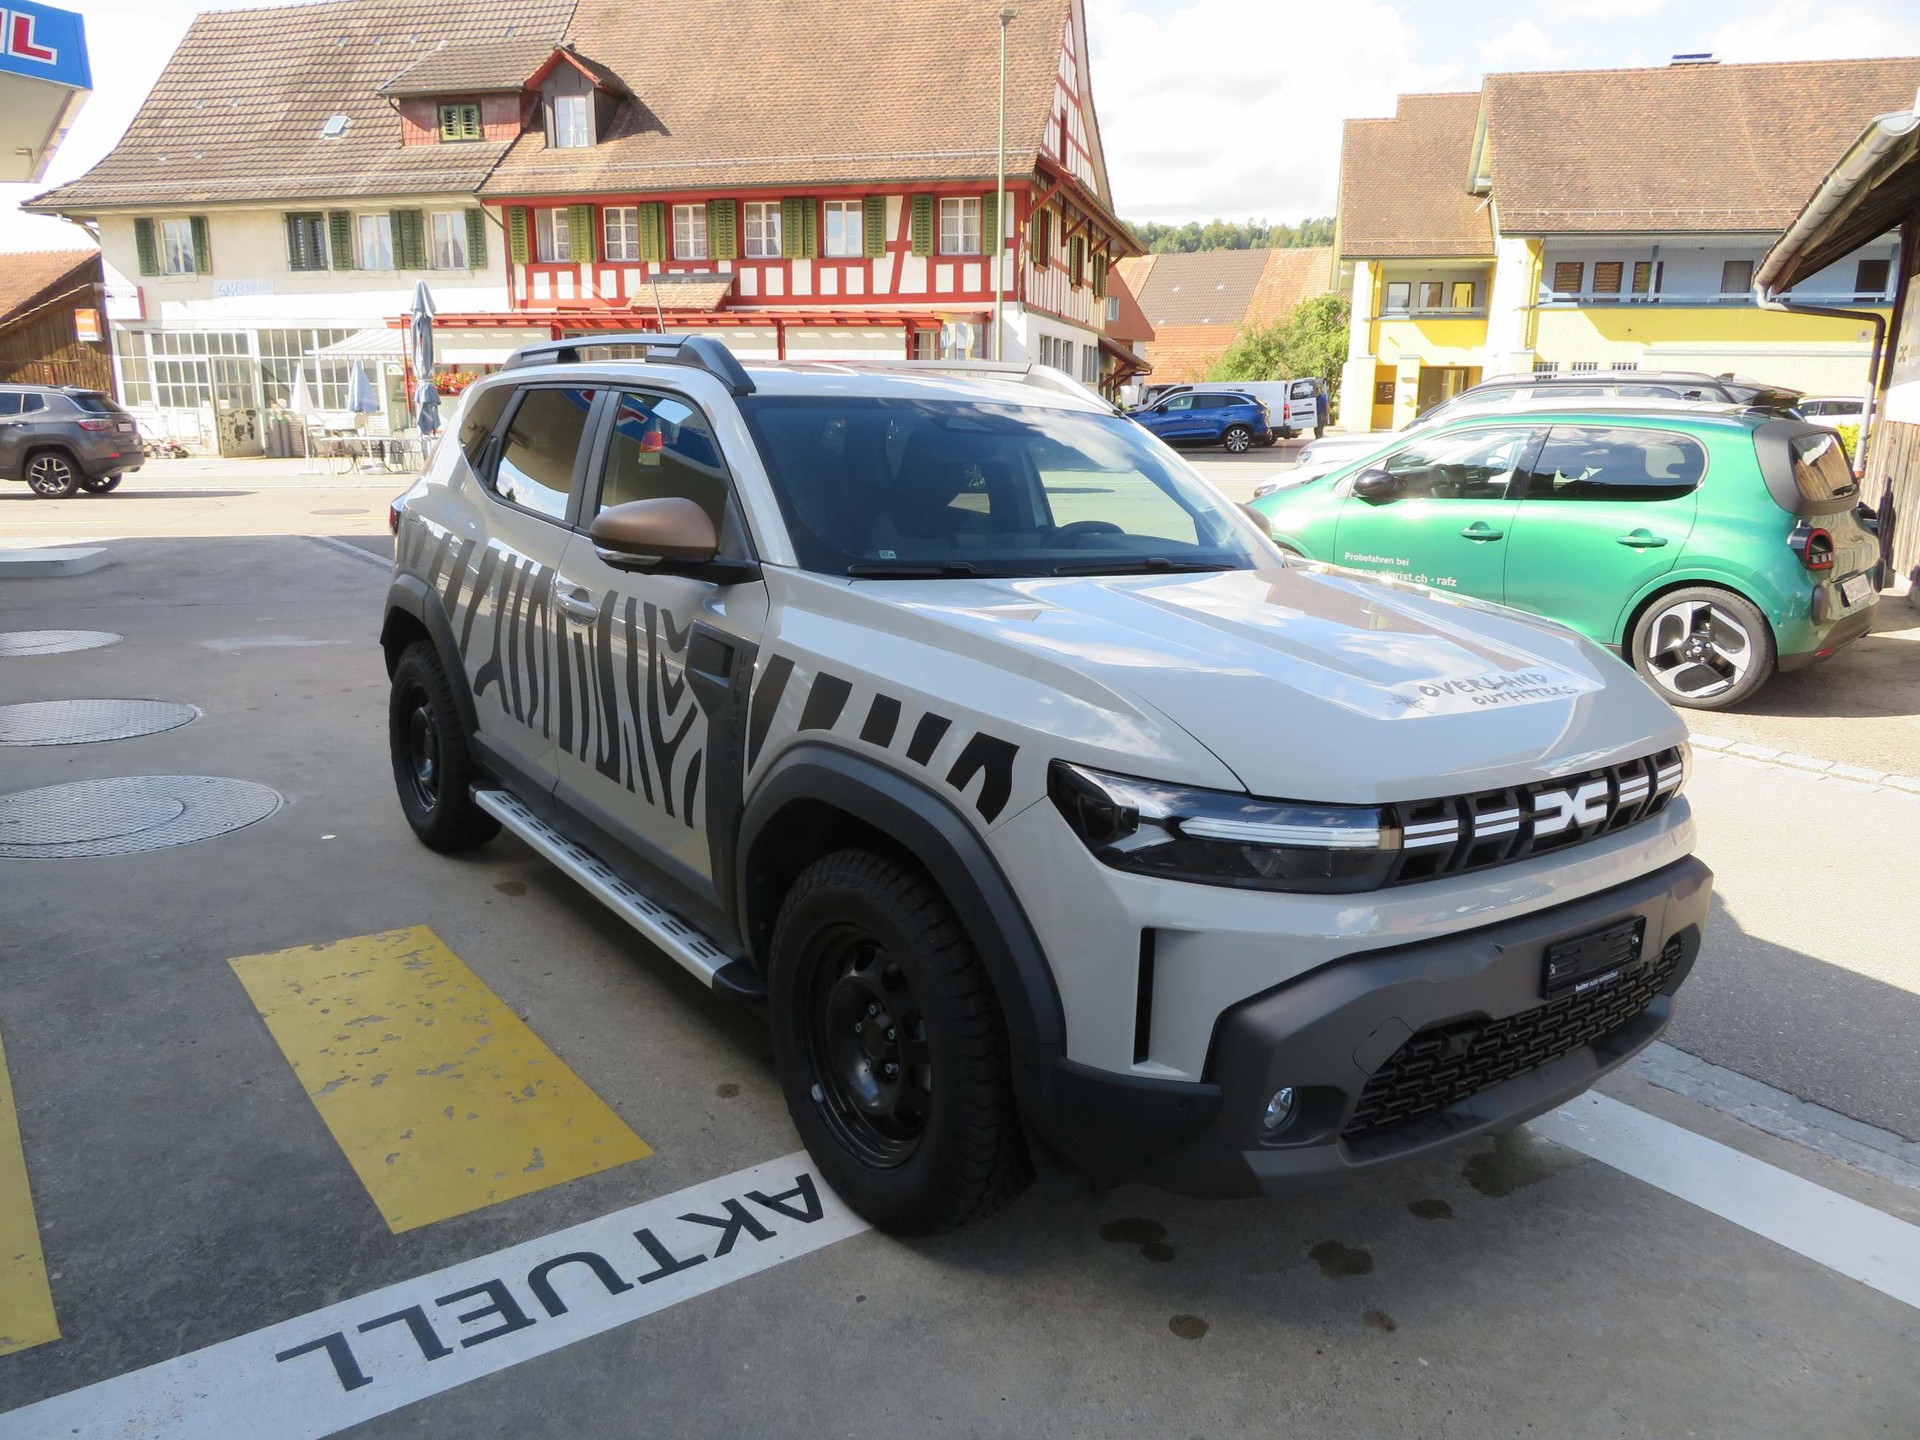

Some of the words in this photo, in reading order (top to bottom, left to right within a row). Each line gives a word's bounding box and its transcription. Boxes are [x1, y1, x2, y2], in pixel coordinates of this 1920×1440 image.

[1345, 552, 1394, 565] Probefahren
[1396, 557, 1409, 567] bei
[1436, 576, 1457, 587] rafz
[1418, 673, 1548, 697] OVERLAND
[1472, 686, 1579, 705] OUTFITTERS
[275, 1173, 825, 1392] AKTUELL
